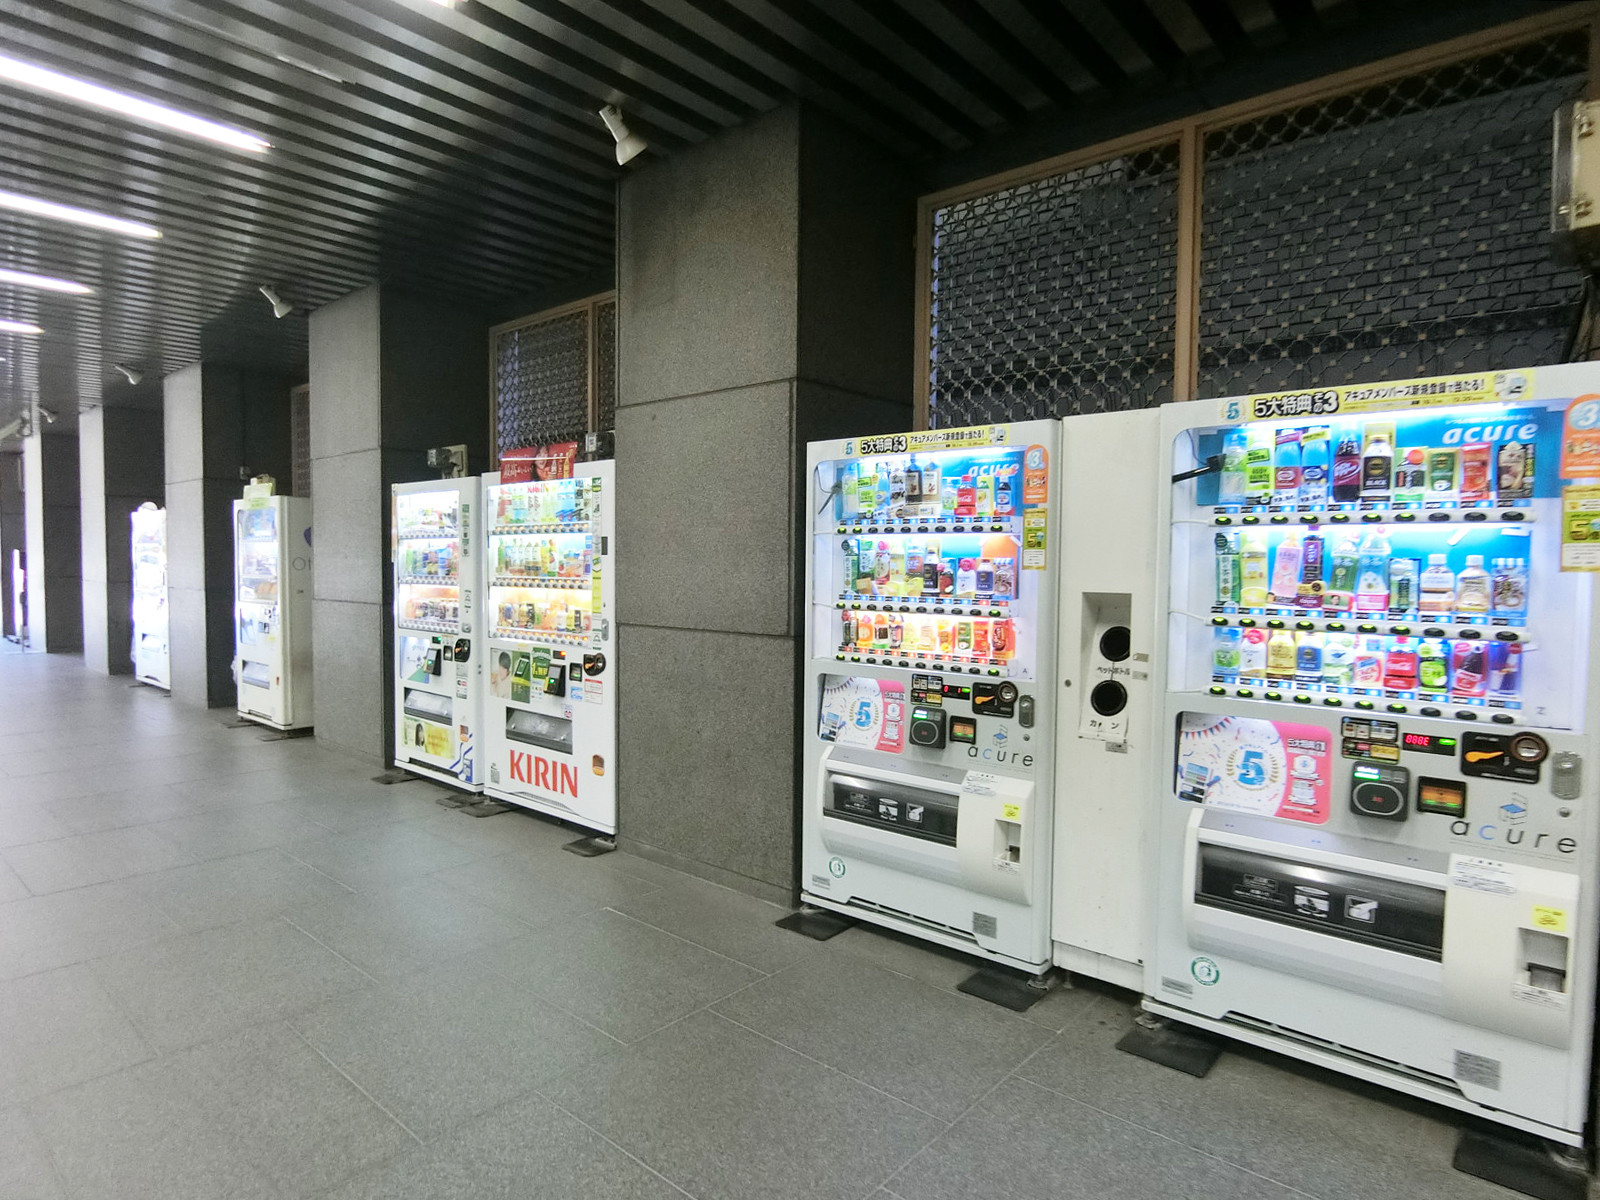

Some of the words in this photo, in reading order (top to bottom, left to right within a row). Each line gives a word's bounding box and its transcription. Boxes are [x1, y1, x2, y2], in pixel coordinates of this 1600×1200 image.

[1442, 422, 1539, 445] acure
[856, 701, 872, 728] 5
[967, 745, 1034, 767] acure
[1238, 750, 1266, 786] 5
[510, 749, 578, 798] KIRIN
[1450, 820, 1577, 854] acure
